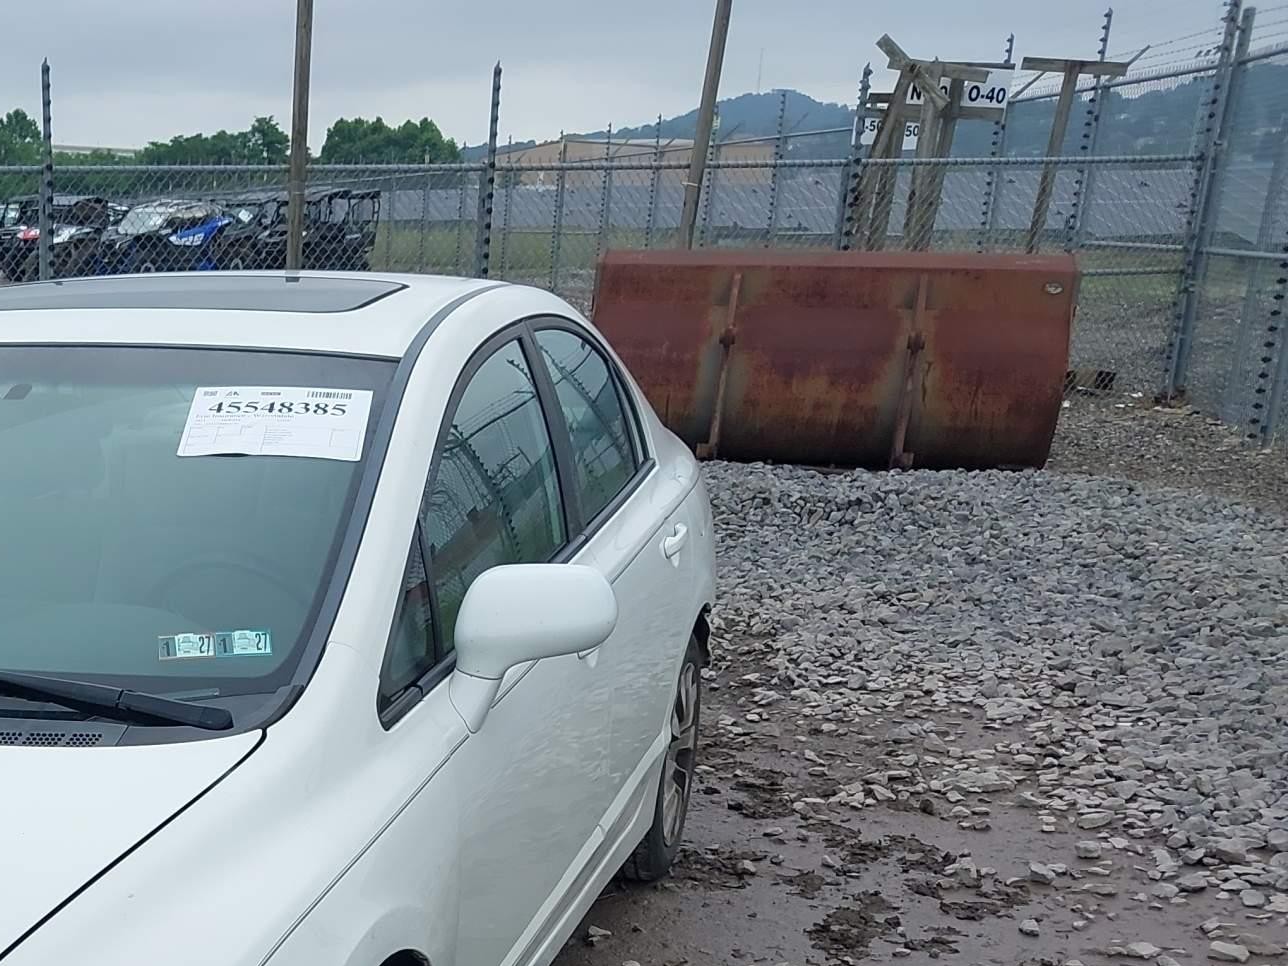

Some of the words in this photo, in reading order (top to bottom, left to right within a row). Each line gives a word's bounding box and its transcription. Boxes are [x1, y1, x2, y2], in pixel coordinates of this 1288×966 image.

[968, 85, 1007, 104] O-40
[208, 401, 348, 416] 45548385
[198, 635, 211, 655] 27
[255, 632, 267, 651] 27
